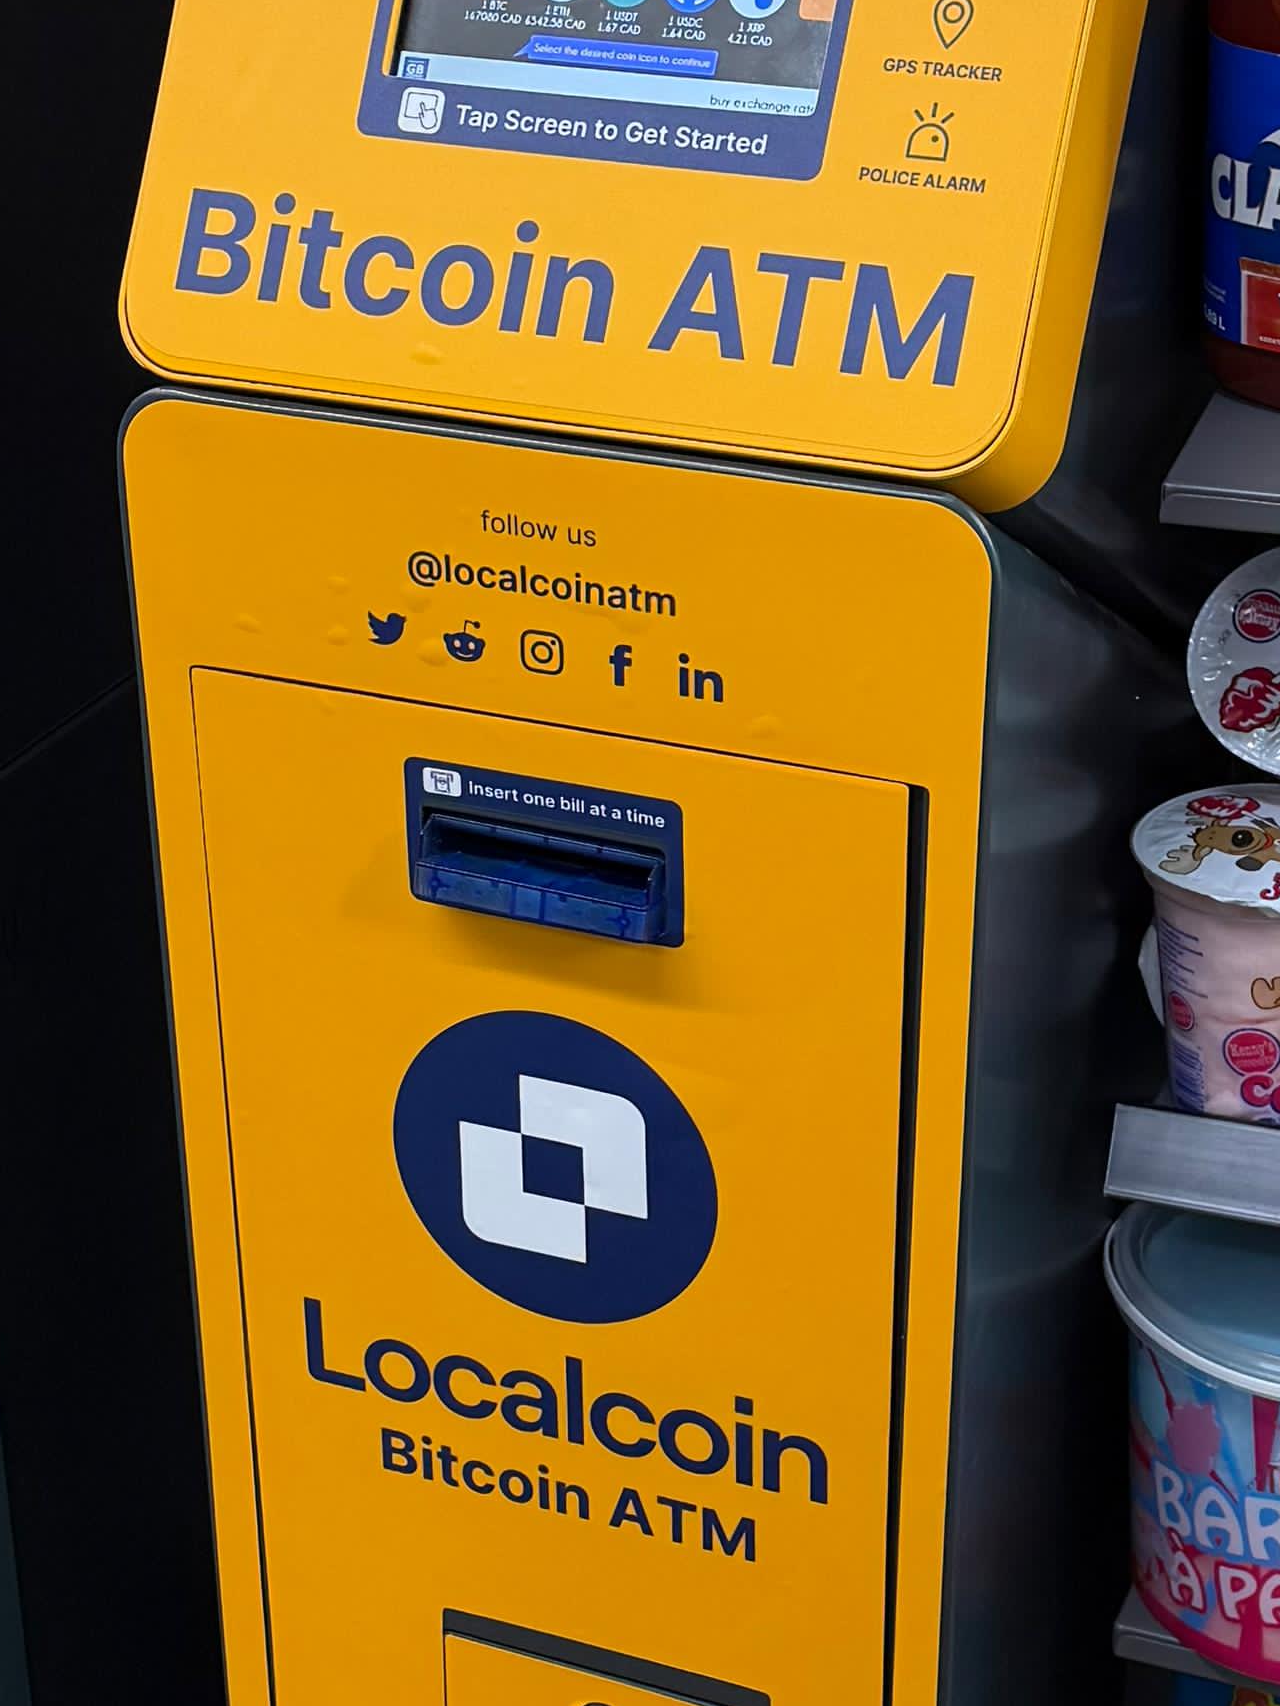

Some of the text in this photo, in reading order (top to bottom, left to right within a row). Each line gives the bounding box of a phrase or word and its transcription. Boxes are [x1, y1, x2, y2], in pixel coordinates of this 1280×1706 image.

[883, 57, 1002, 82] GPS TRACKER
[456, 104, 768, 156] Tap Screen to Get Started
[859, 167, 985, 194] POLICE ALARM
[174, 187, 976, 388] Bitcoin ATM
[480, 509, 598, 548] follow us
[407, 551, 678, 618] @localcoinatm
[467, 779, 666, 829] Insert one bill at a time
[303, 1297, 829, 1504] Localcoin
[381, 1427, 756, 1562] Bitcoin ATM
